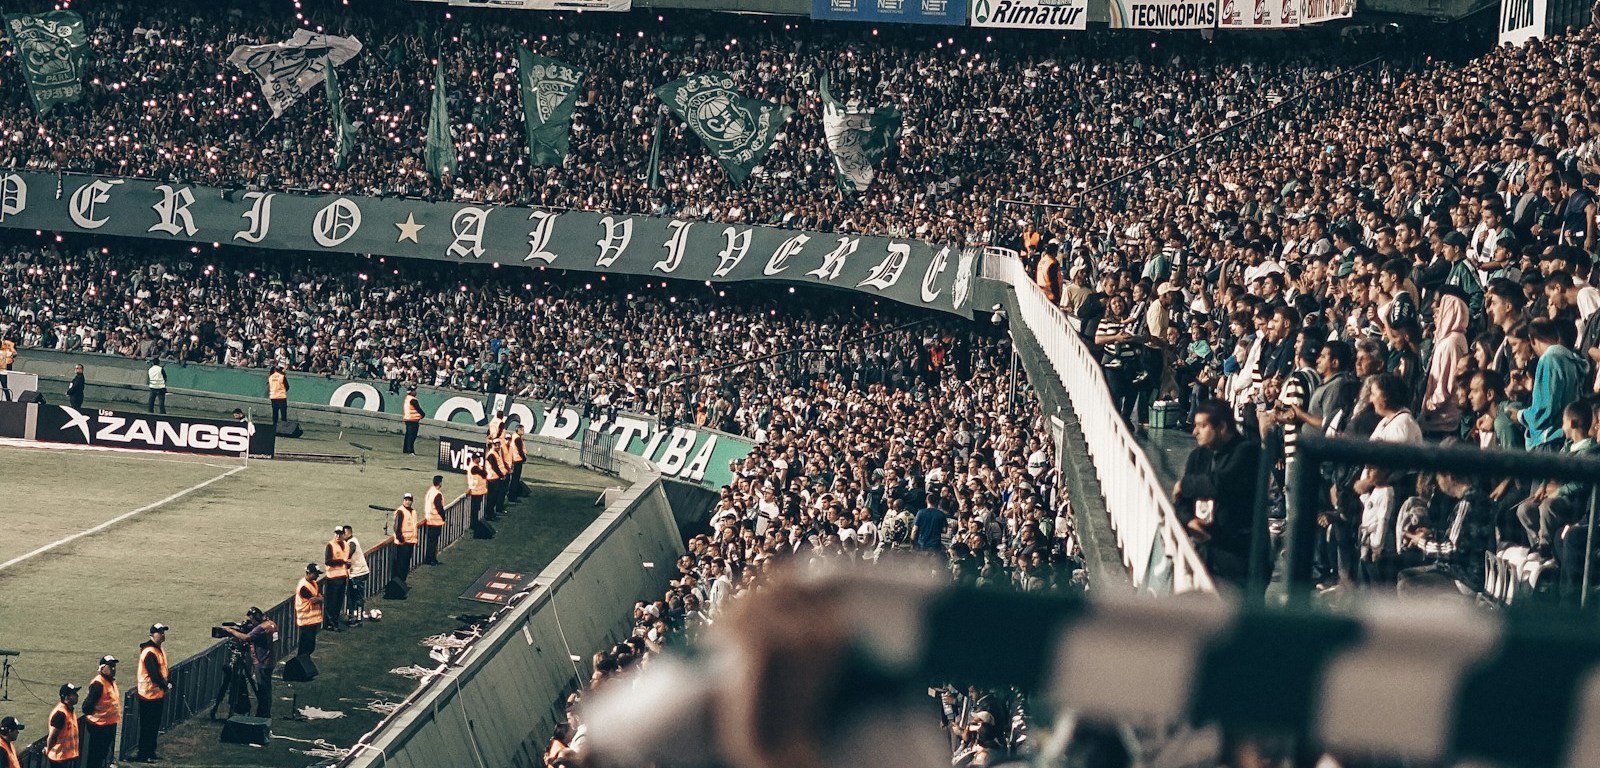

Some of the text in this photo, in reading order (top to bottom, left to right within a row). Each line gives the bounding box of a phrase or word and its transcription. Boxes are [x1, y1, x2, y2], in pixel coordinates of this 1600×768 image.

[921, 0, 948, 11] NET
[991, 0, 1084, 25] Rimatur
[1132, 0, 1215, 26] TECNICÓPIAS
[446, 207, 951, 303] ALVIVERDE
[99, 409, 114, 417] Use
[96, 416, 248, 452] ZANGS
